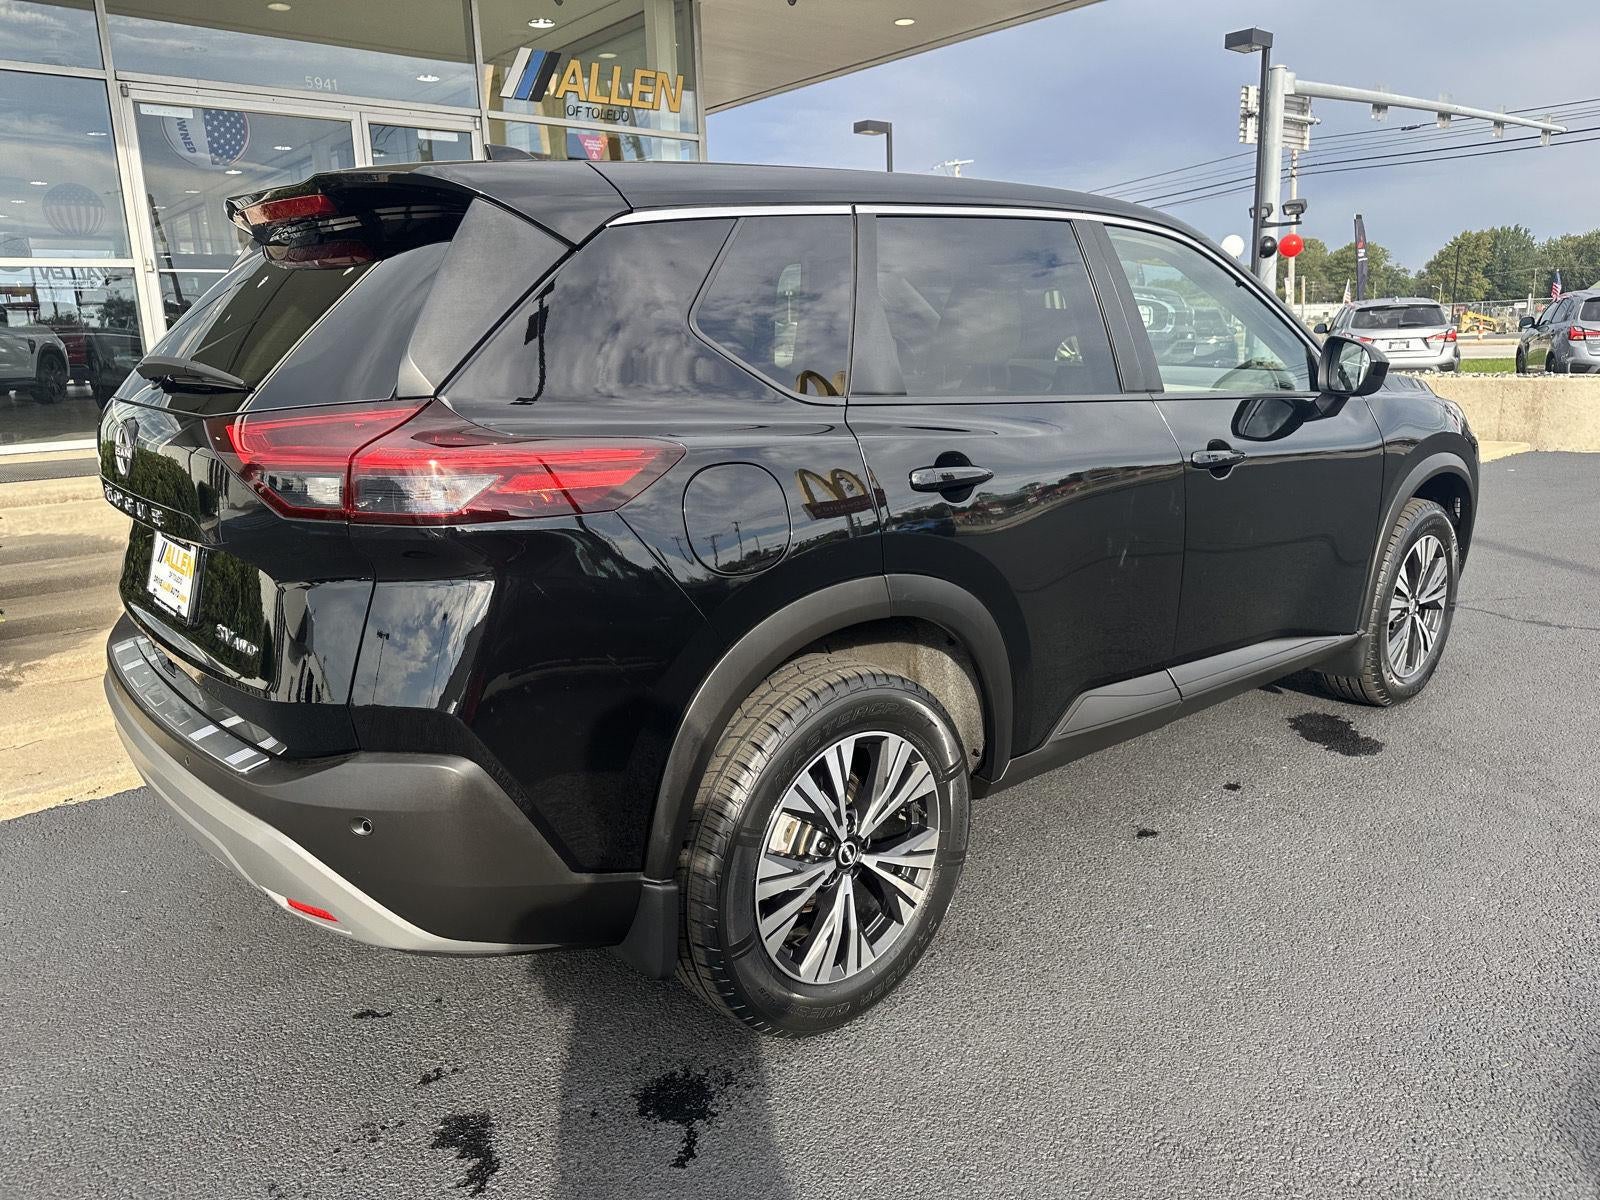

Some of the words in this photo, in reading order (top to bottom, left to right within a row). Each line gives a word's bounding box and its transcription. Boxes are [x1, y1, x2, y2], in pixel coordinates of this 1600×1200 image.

[304, 75, 338, 92] 5941
[555, 58, 685, 114] ALLEN
[566, 104, 582, 118] OF
[585, 106, 630, 122] TOLEDO
[164, 543, 195, 580] ALLEN
